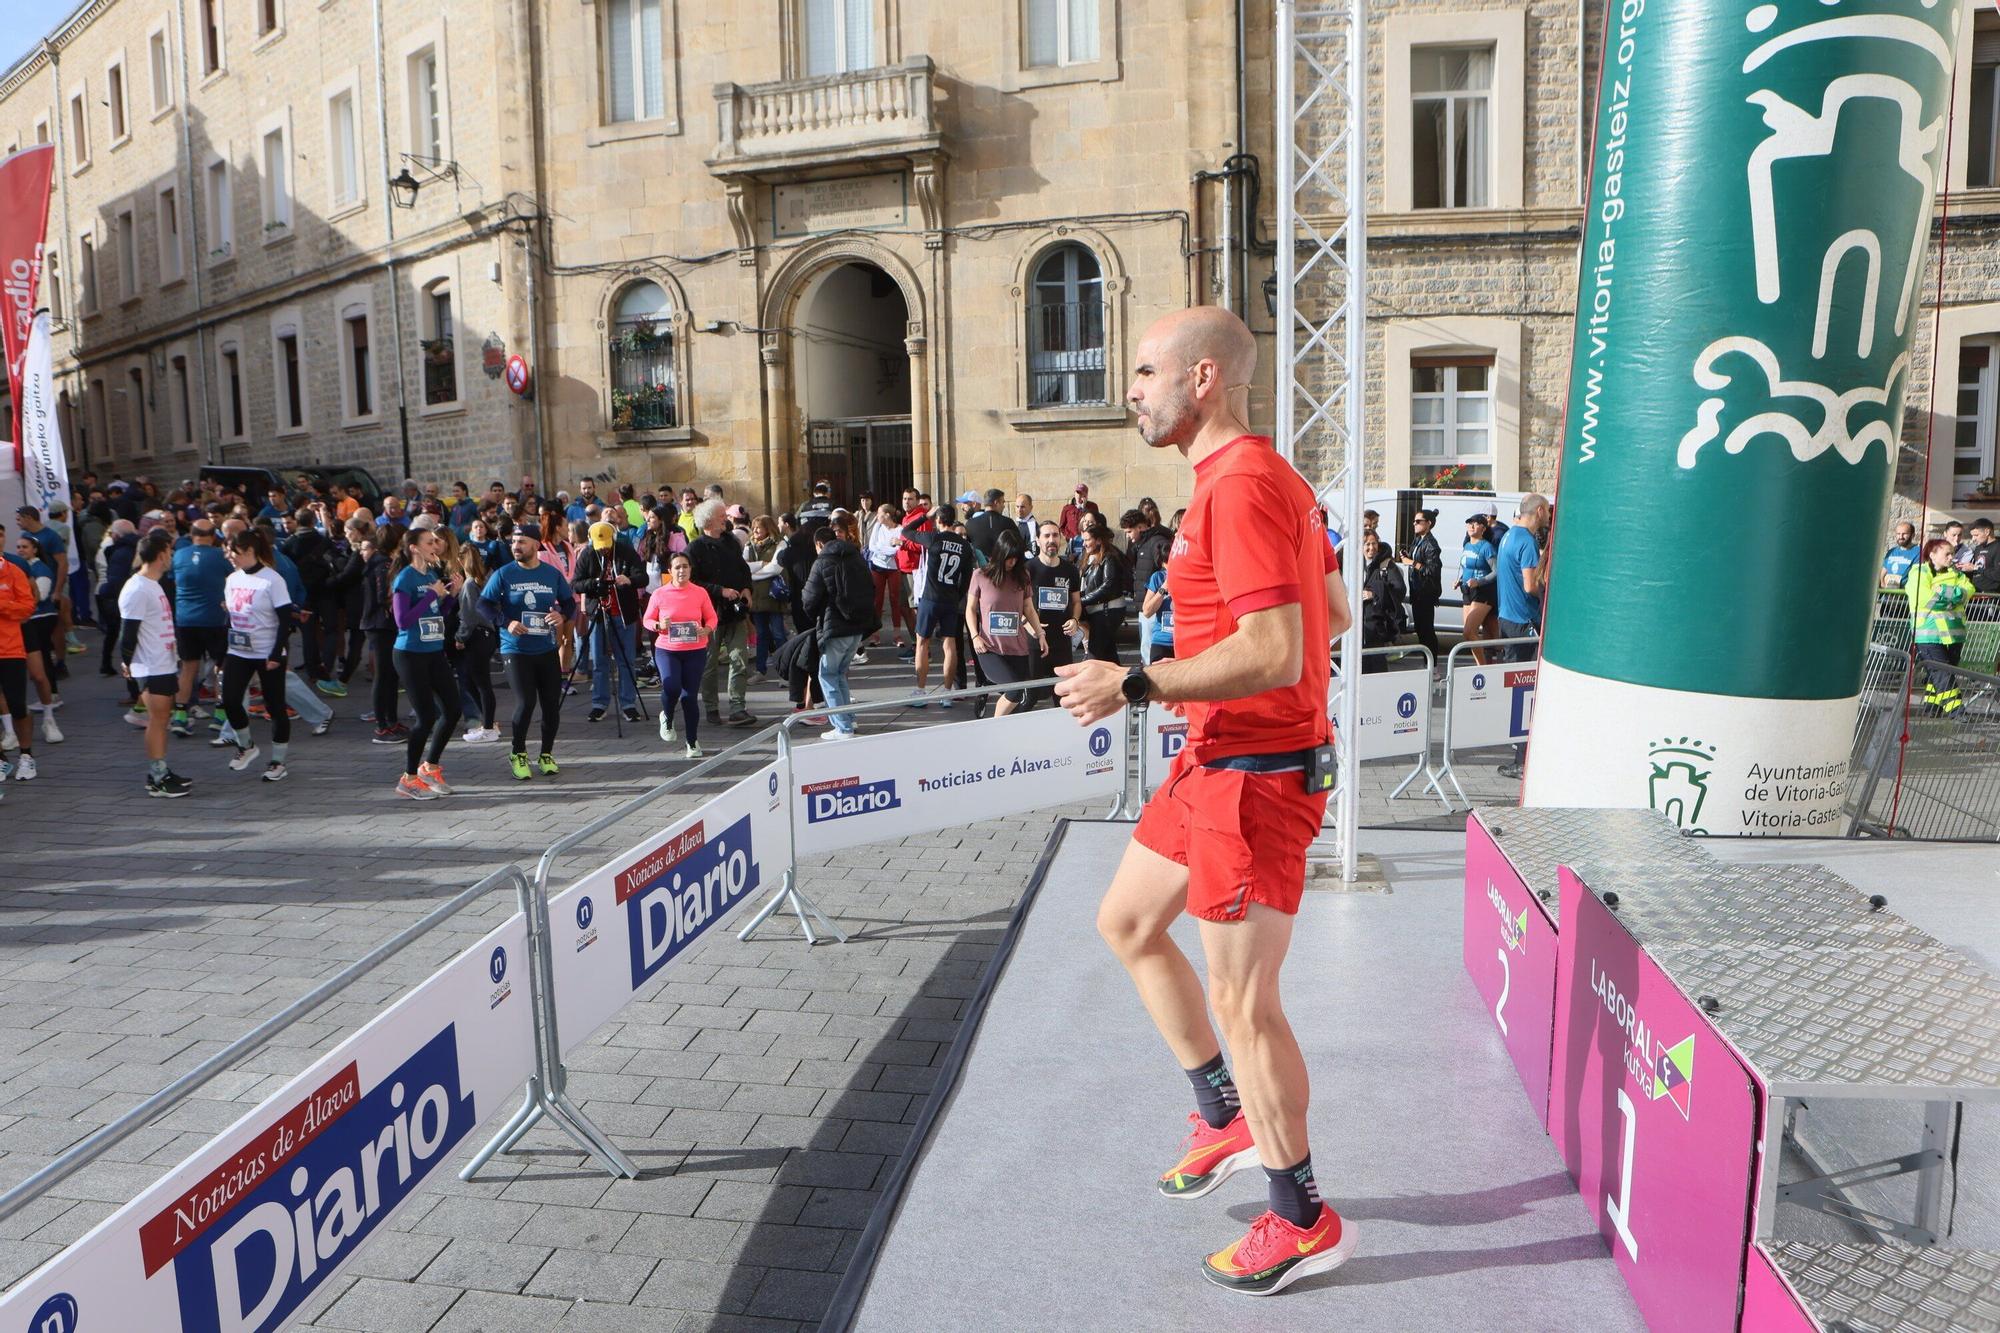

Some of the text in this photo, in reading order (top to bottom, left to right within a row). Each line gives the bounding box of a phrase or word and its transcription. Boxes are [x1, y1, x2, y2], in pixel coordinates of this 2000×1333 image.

[1579, 0, 1645, 464] www.vitoria-gasteiz.org
[4, 258, 31, 341] radio
[33, 373, 62, 491] garuneko gaitza
[937, 552, 961, 585] 12
[998, 617, 1013, 628] 937
[1393, 719, 1418, 729] noticias
[807, 782, 832, 793] Noticias
[832, 780, 840, 789] de
[920, 769, 982, 792] noticias
[987, 764, 1006, 779] de
[1086, 758, 1114, 769] noticias
[1747, 762, 1847, 784] Ayuntamiento
[815, 785, 891, 820] Diario
[1744, 784, 1769, 801] de
[626, 830, 702, 893] Noticias de Álava
[640, 841, 747, 970] Diario
[1487, 876, 1514, 932] LABORAL
[576, 927, 598, 945] noticias
[490, 980, 511, 1002] noticias
[1495, 948, 1510, 1037] 2
[1591, 958, 1654, 1069] LABORAL
[1623, 1041, 1653, 1101] kutxa
[173, 1078, 356, 1246] Noticias de Álava
[1607, 1087, 1638, 1265] 1
[210, 1081, 450, 1333] Diario
